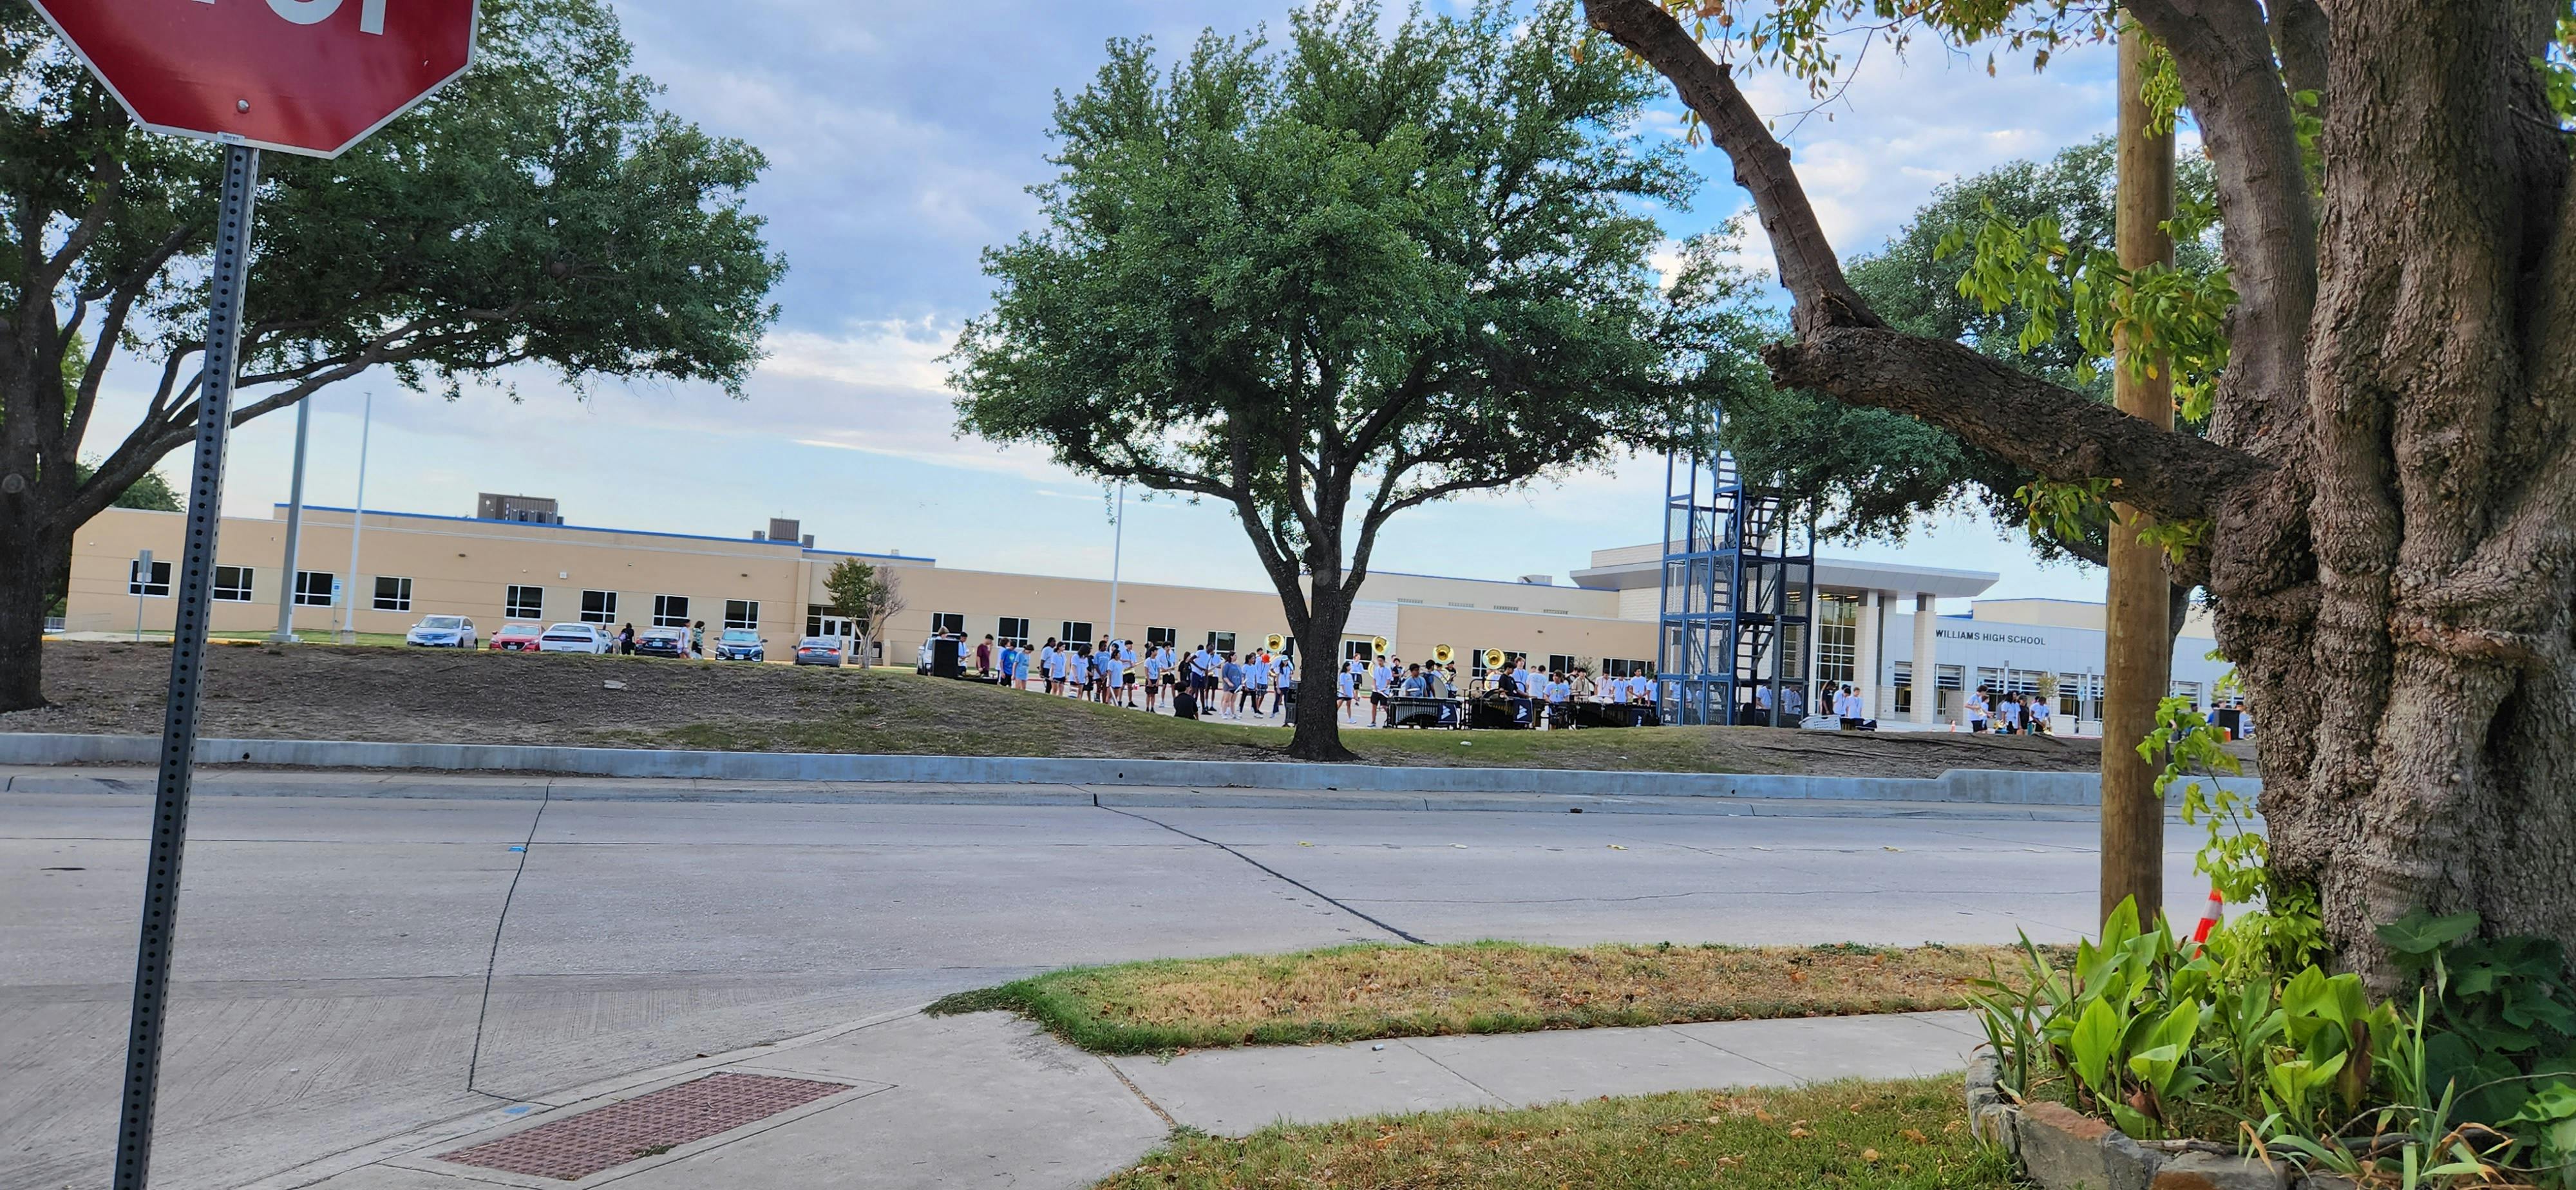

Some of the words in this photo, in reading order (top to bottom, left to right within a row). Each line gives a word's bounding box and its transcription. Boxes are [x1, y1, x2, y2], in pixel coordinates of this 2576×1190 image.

[1936, 629, 1980, 640] WILLIAMS
[1983, 633, 2005, 642] HIGH
[2007, 635, 2046, 645] SCHOOL
